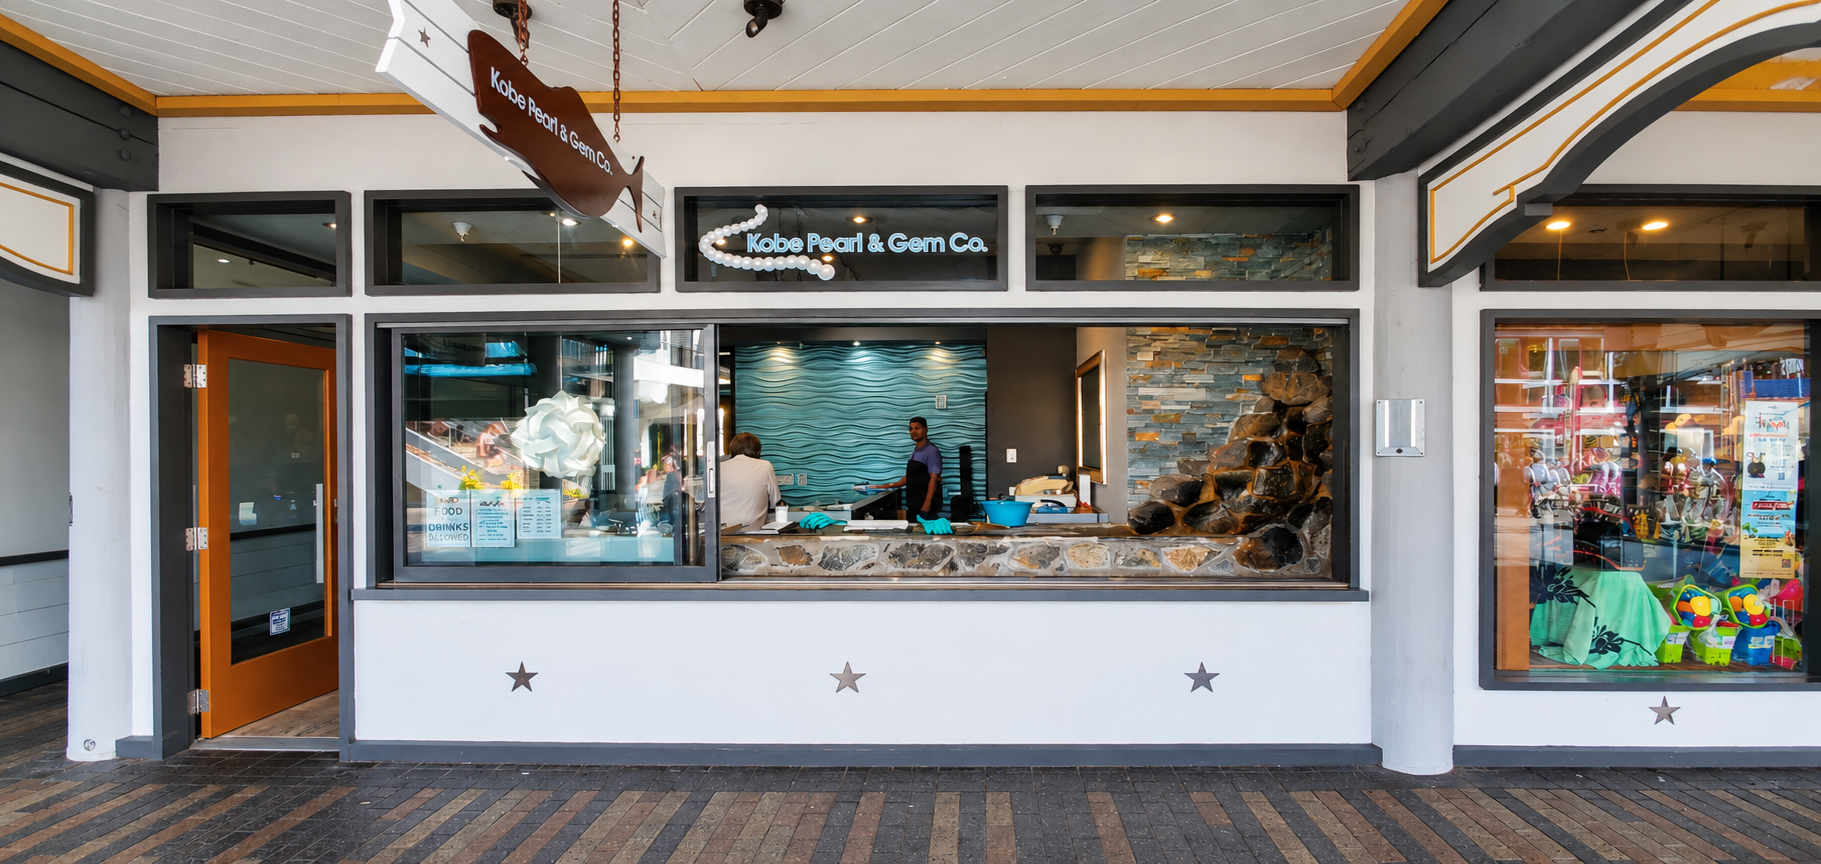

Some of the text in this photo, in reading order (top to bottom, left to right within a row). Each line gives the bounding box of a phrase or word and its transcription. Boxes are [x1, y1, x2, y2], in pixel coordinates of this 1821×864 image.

[490, 66, 613, 175] Kobe Pearl & Gem Co.
[746, 232, 989, 253] Kobe Pearl & Gem Co.
[434, 507, 463, 516] FOOD
